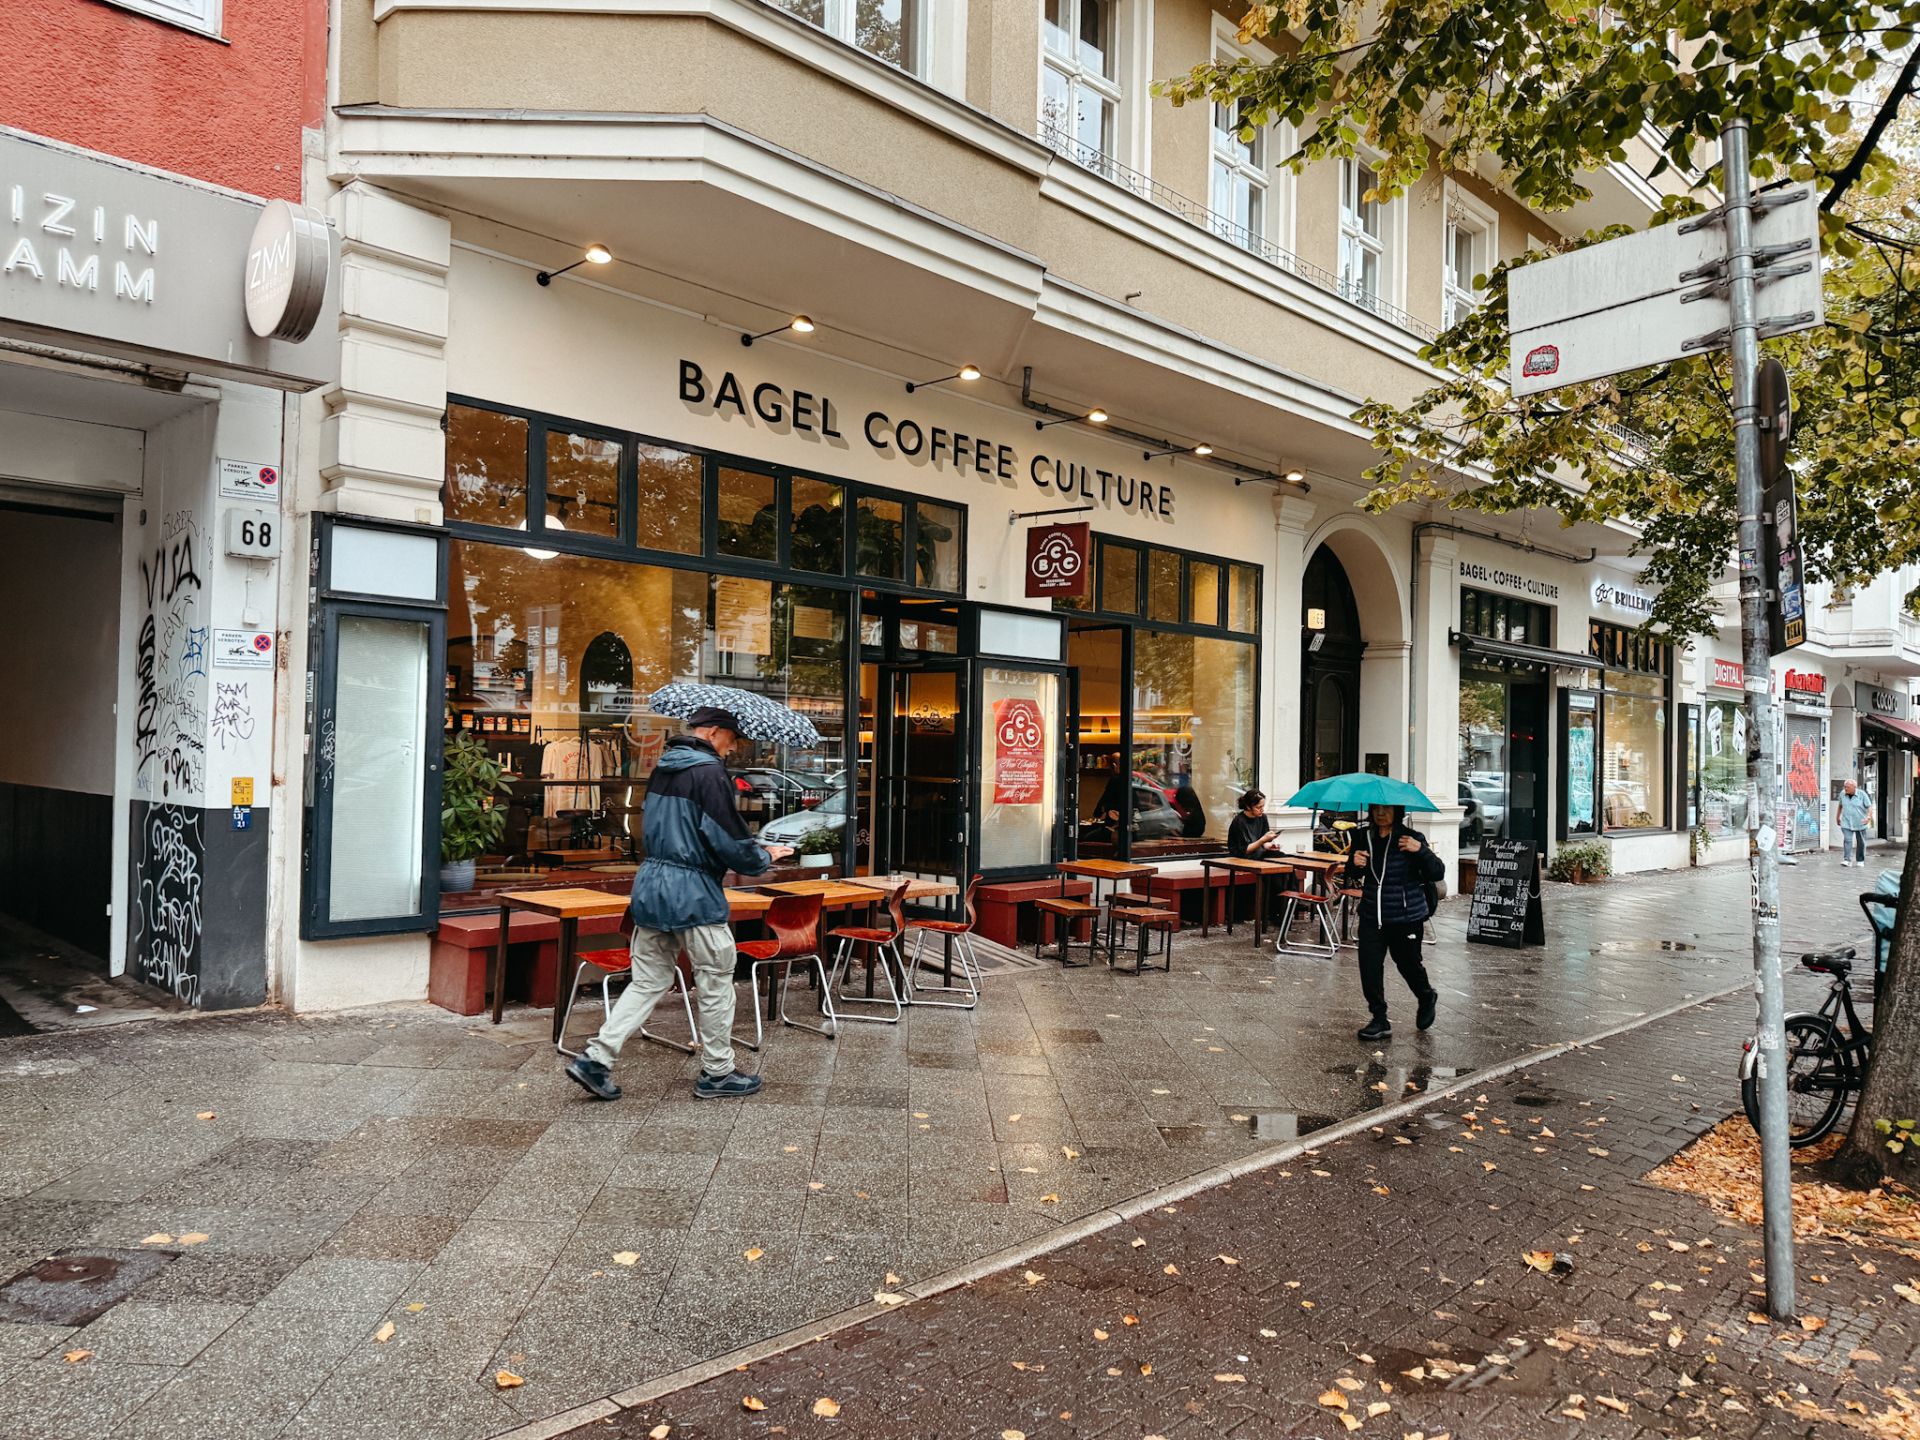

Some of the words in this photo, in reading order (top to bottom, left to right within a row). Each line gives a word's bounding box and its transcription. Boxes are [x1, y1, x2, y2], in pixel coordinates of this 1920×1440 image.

[11, 184, 159, 255] IZIN
[3, 238, 156, 304] AMM
[249, 230, 292, 290] ZMM
[678, 358, 842, 439] BAGEL
[863, 410, 1014, 480] COFFEE
[1029, 454, 1174, 517] CULTURE
[241, 519, 272, 548] 68
[1459, 561, 1488, 580] BAGEL
[1493, 569, 1522, 590] COFFEE
[1527, 578, 1559, 599] CULTURE
[1714, 663, 1741, 684] DIGITAL
